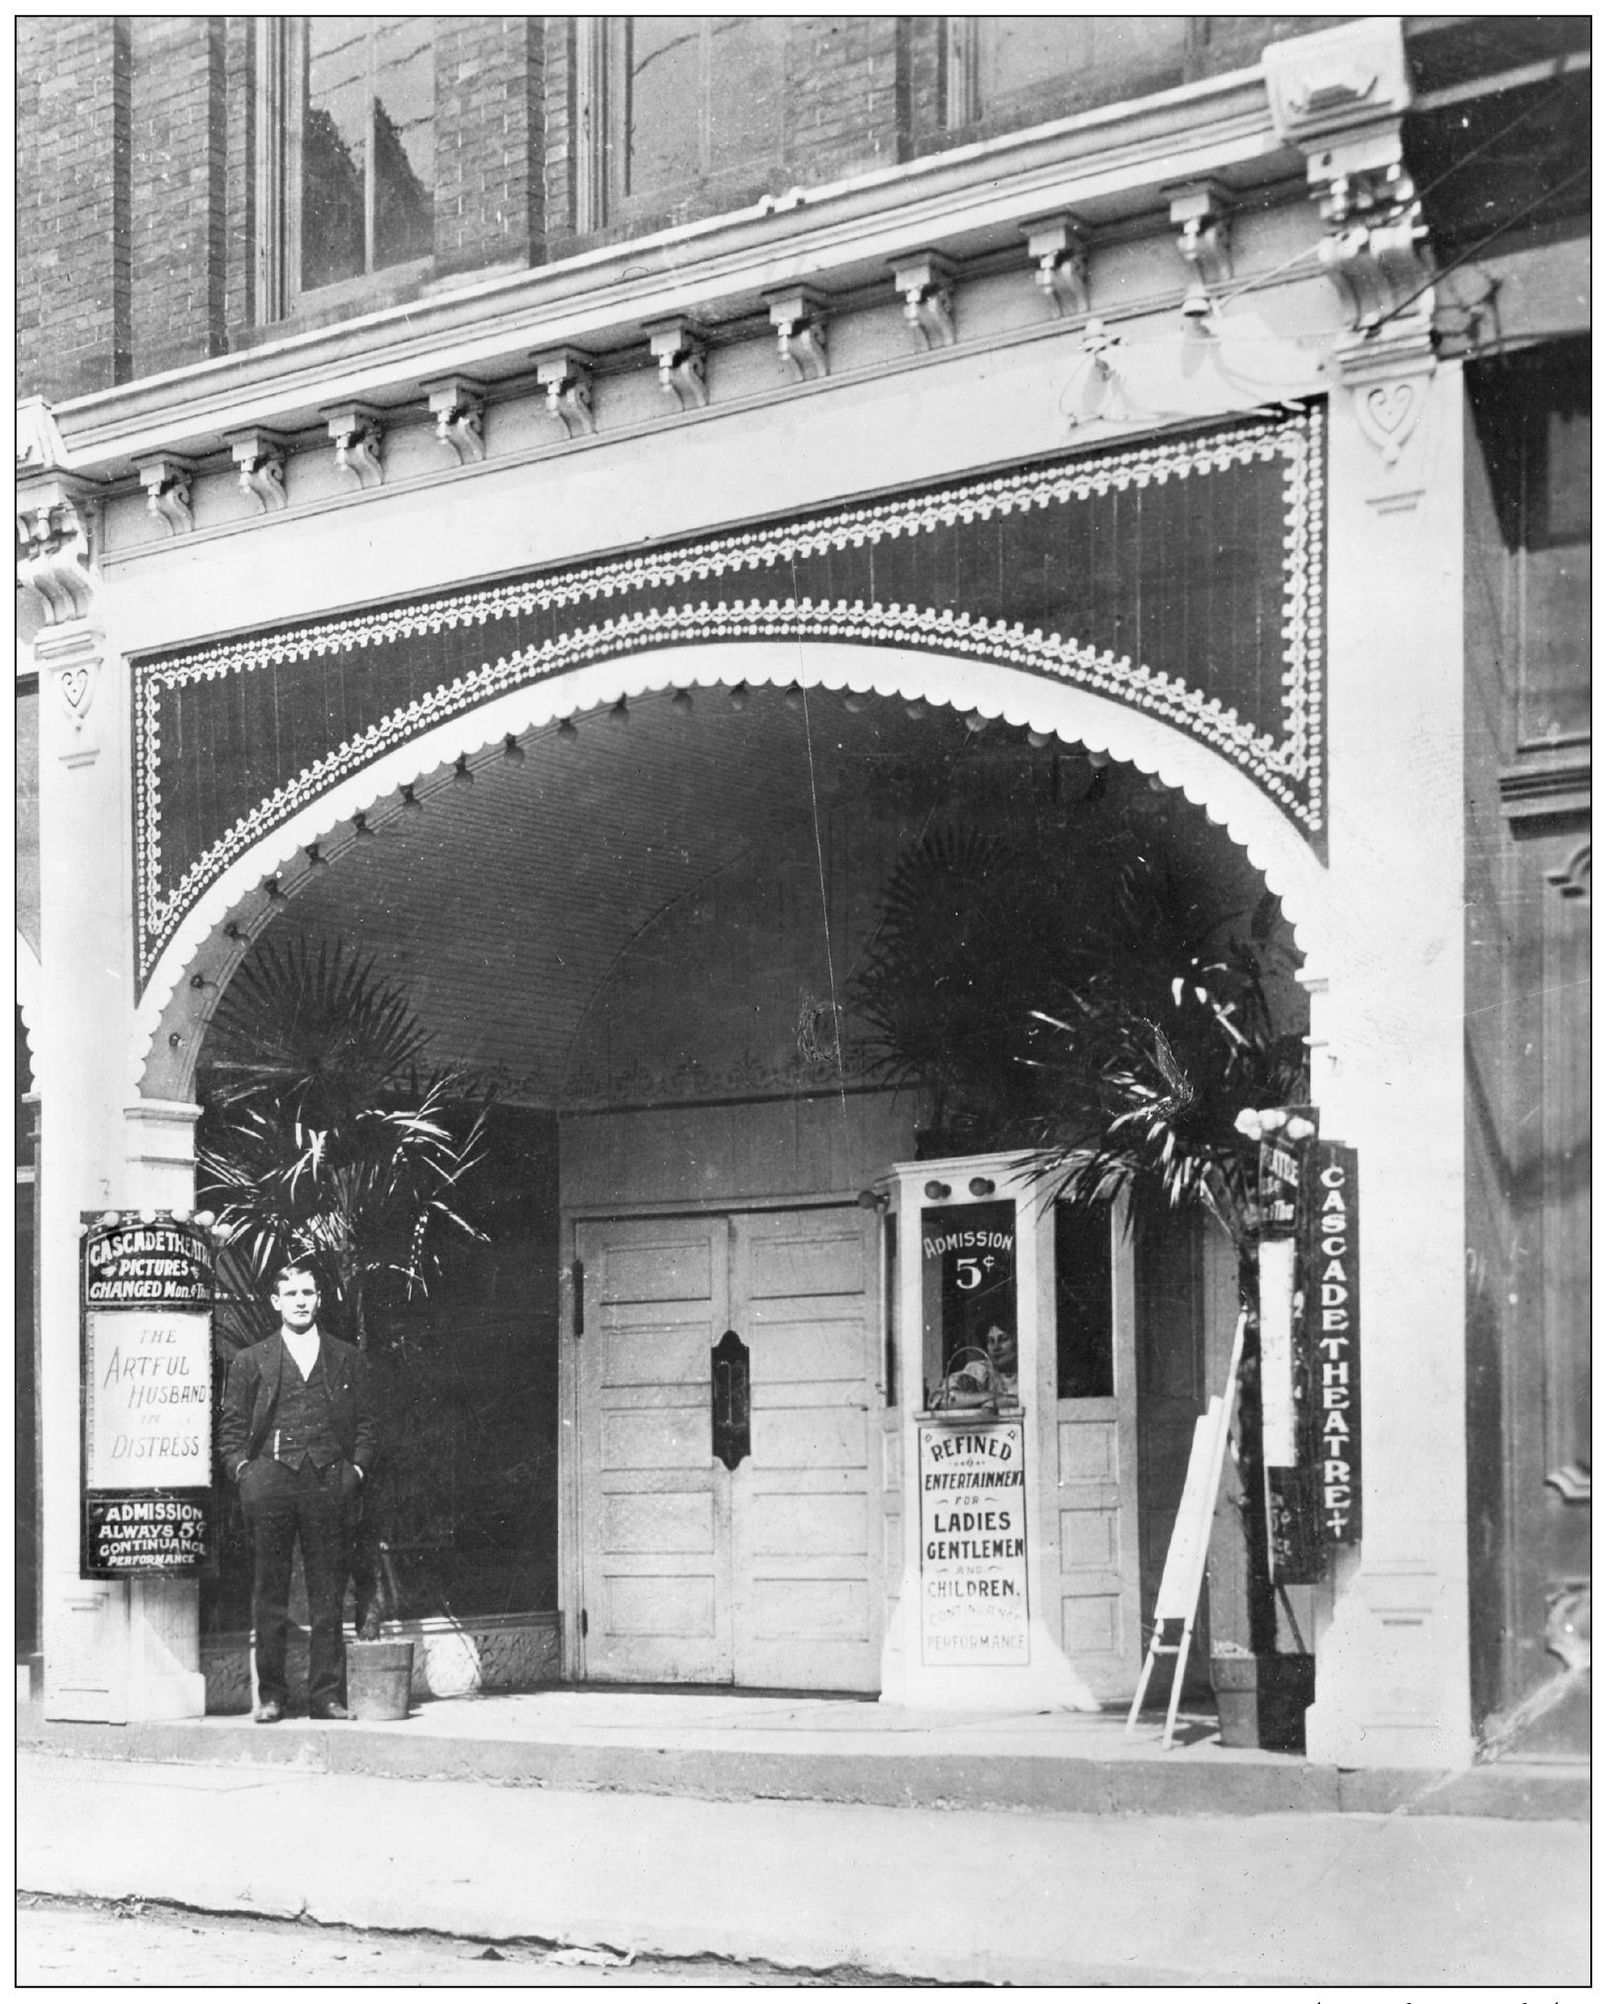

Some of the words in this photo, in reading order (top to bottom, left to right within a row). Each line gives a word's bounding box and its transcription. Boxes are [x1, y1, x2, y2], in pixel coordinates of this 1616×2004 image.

[90, 1232, 165, 1267] CASCADE
[924, 1231, 1013, 1259] ADMISSION
[1320, 1166, 1349, 1331] CASCADE
[119, 1259, 189, 1276] PICTURES
[956, 1254, 995, 1290] 5¢
[90, 1281, 162, 1298] CHANGED
[163, 1281, 191, 1298] Mon.
[140, 1330, 176, 1343] THE
[104, 1346, 189, 1389] ARTFUL
[128, 1385, 206, 1408] HUSBAND
[1320, 1338, 1351, 1508] THEATRE
[110, 1434, 199, 1458] DISTRESS
[931, 1436, 1012, 1462] REFINED
[925, 1471, 1024, 1491] ENTERTAINMENT
[955, 1496, 979, 1505] FOR
[106, 1503, 202, 1521] ADMISSION
[935, 1512, 1011, 1532] LADIES
[99, 1524, 174, 1539] ALWAYS
[927, 1539, 1024, 1560] GENTLEMEN
[107, 1554, 195, 1568] PERFORMANCE
[956, 1566, 983, 1575] AND
[928, 1580, 1020, 1597] CHILDREN.
